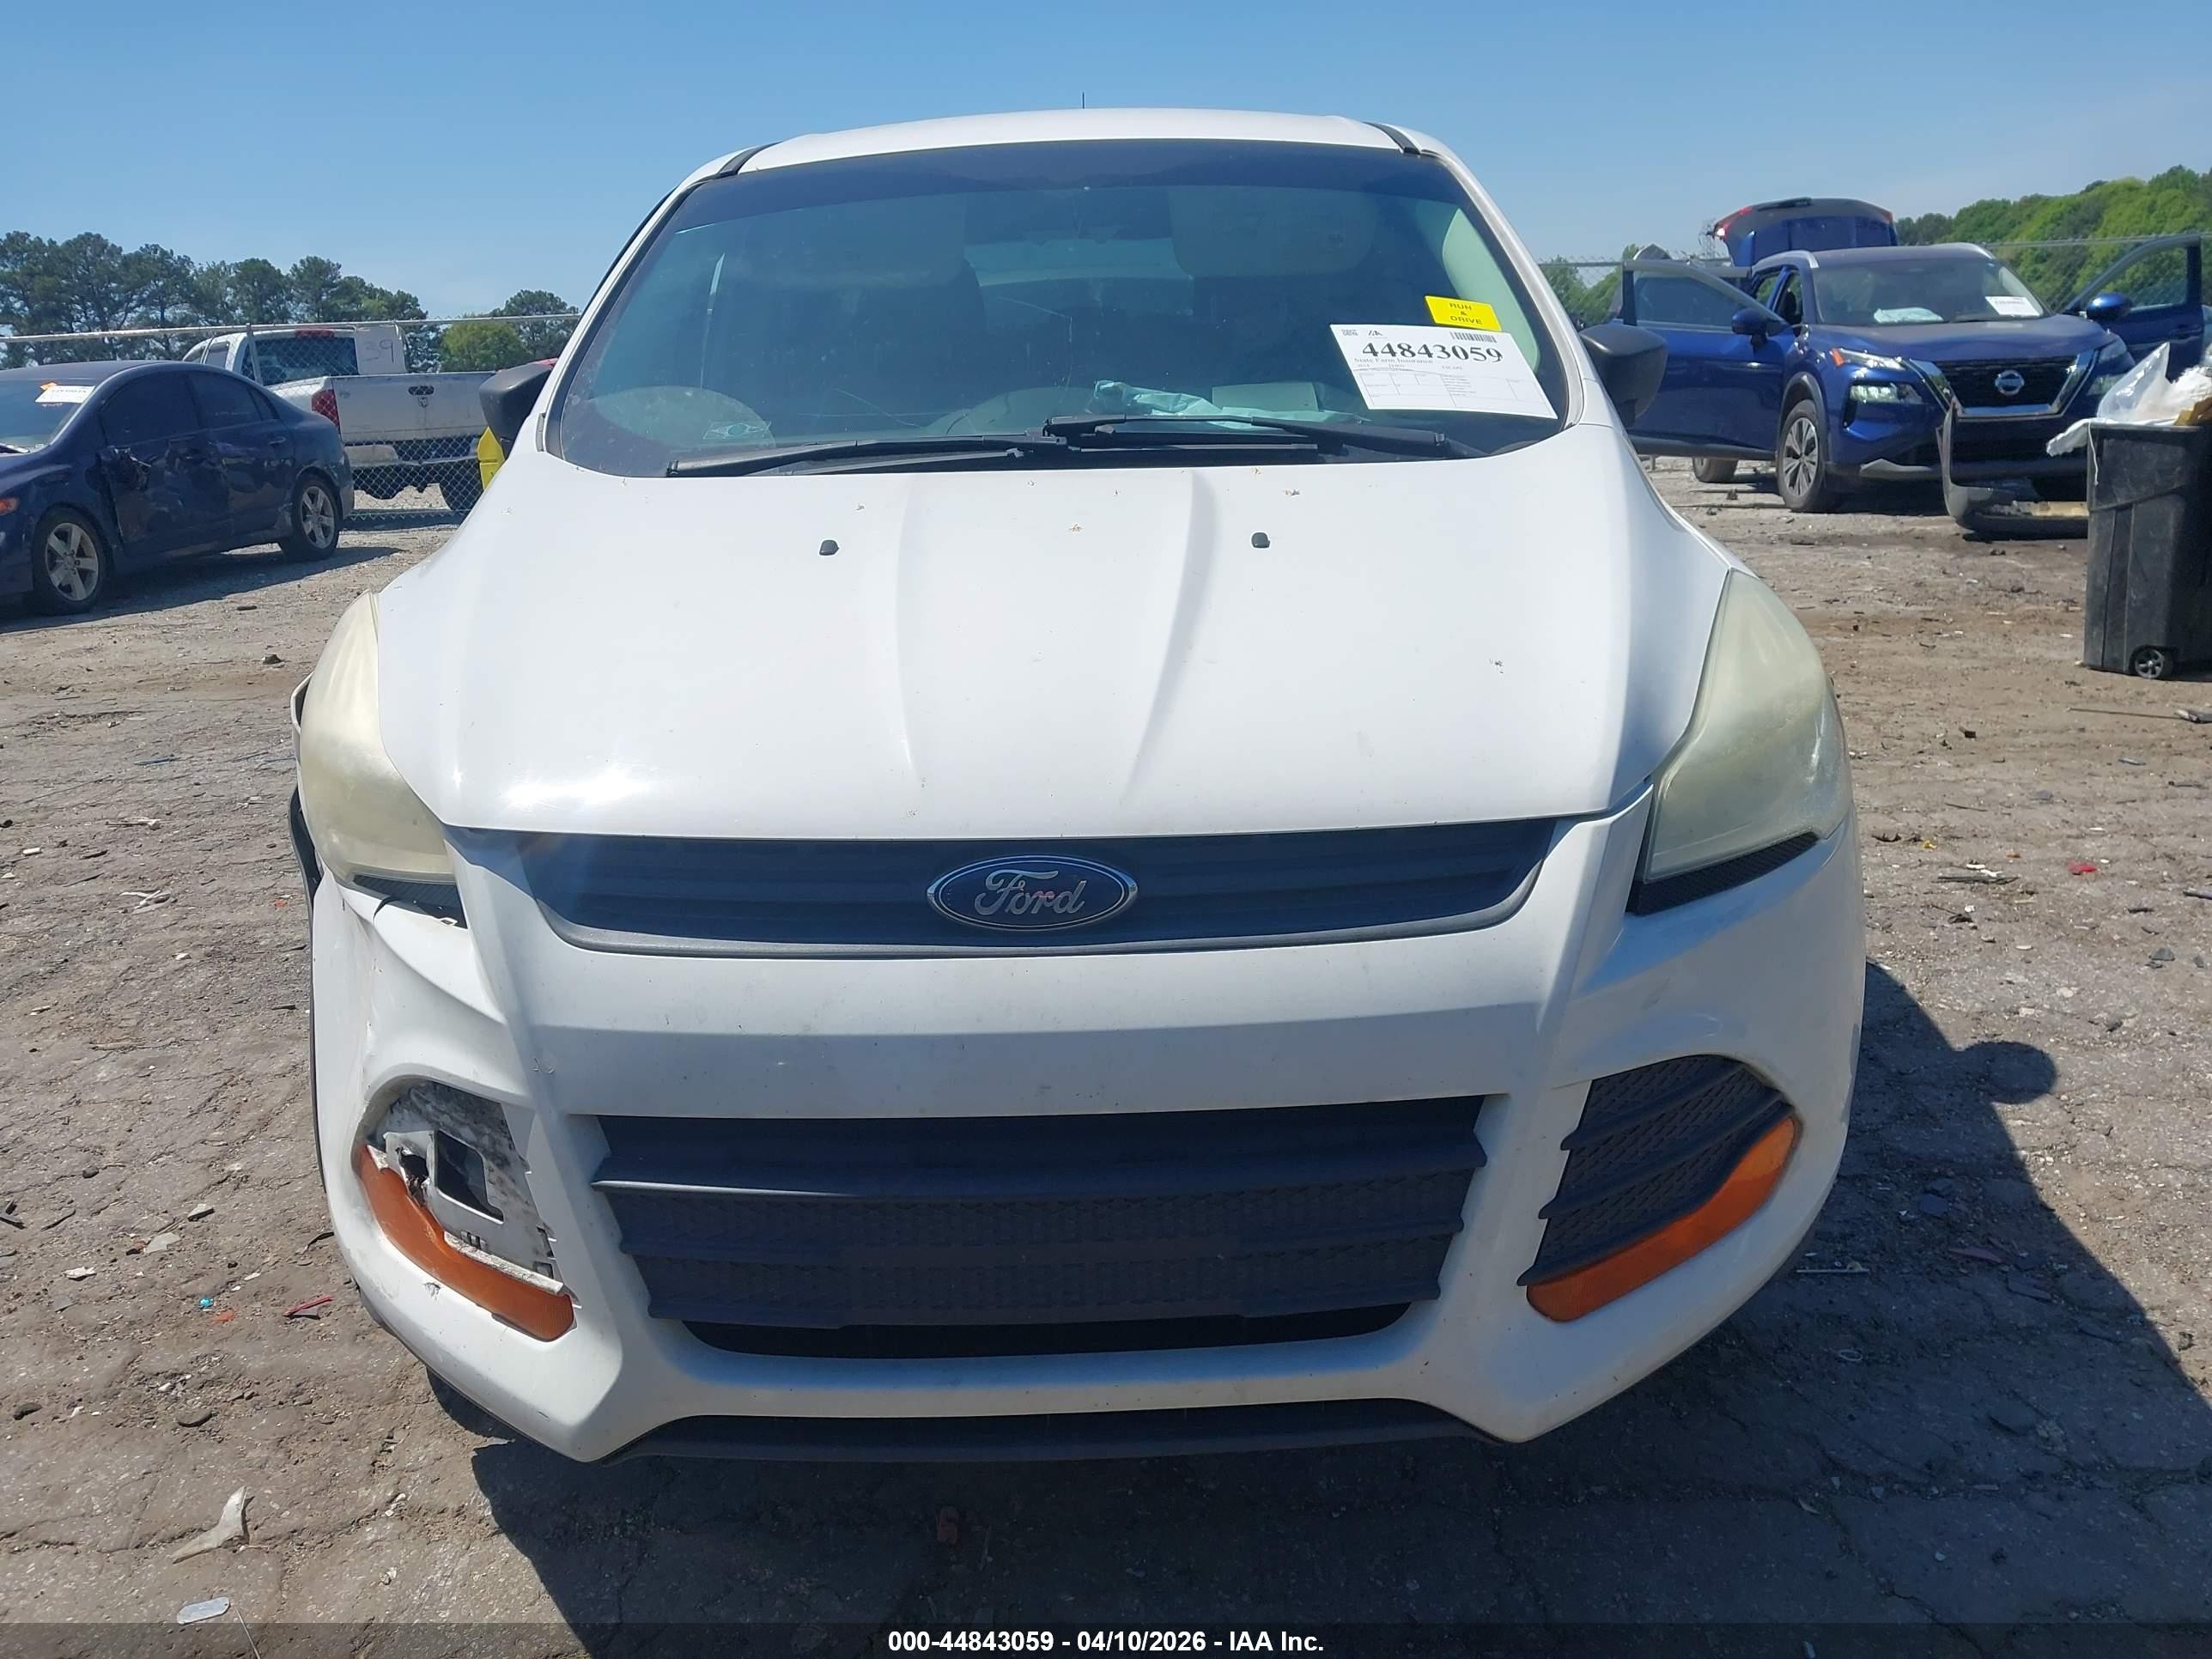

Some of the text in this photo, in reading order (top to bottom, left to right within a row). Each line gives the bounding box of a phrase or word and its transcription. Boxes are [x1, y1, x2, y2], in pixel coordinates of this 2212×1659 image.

[1449, 315, 1483, 325] DRIVE
[1362, 342, 1504, 363] 44843059
[974, 869, 1087, 915] Ford
